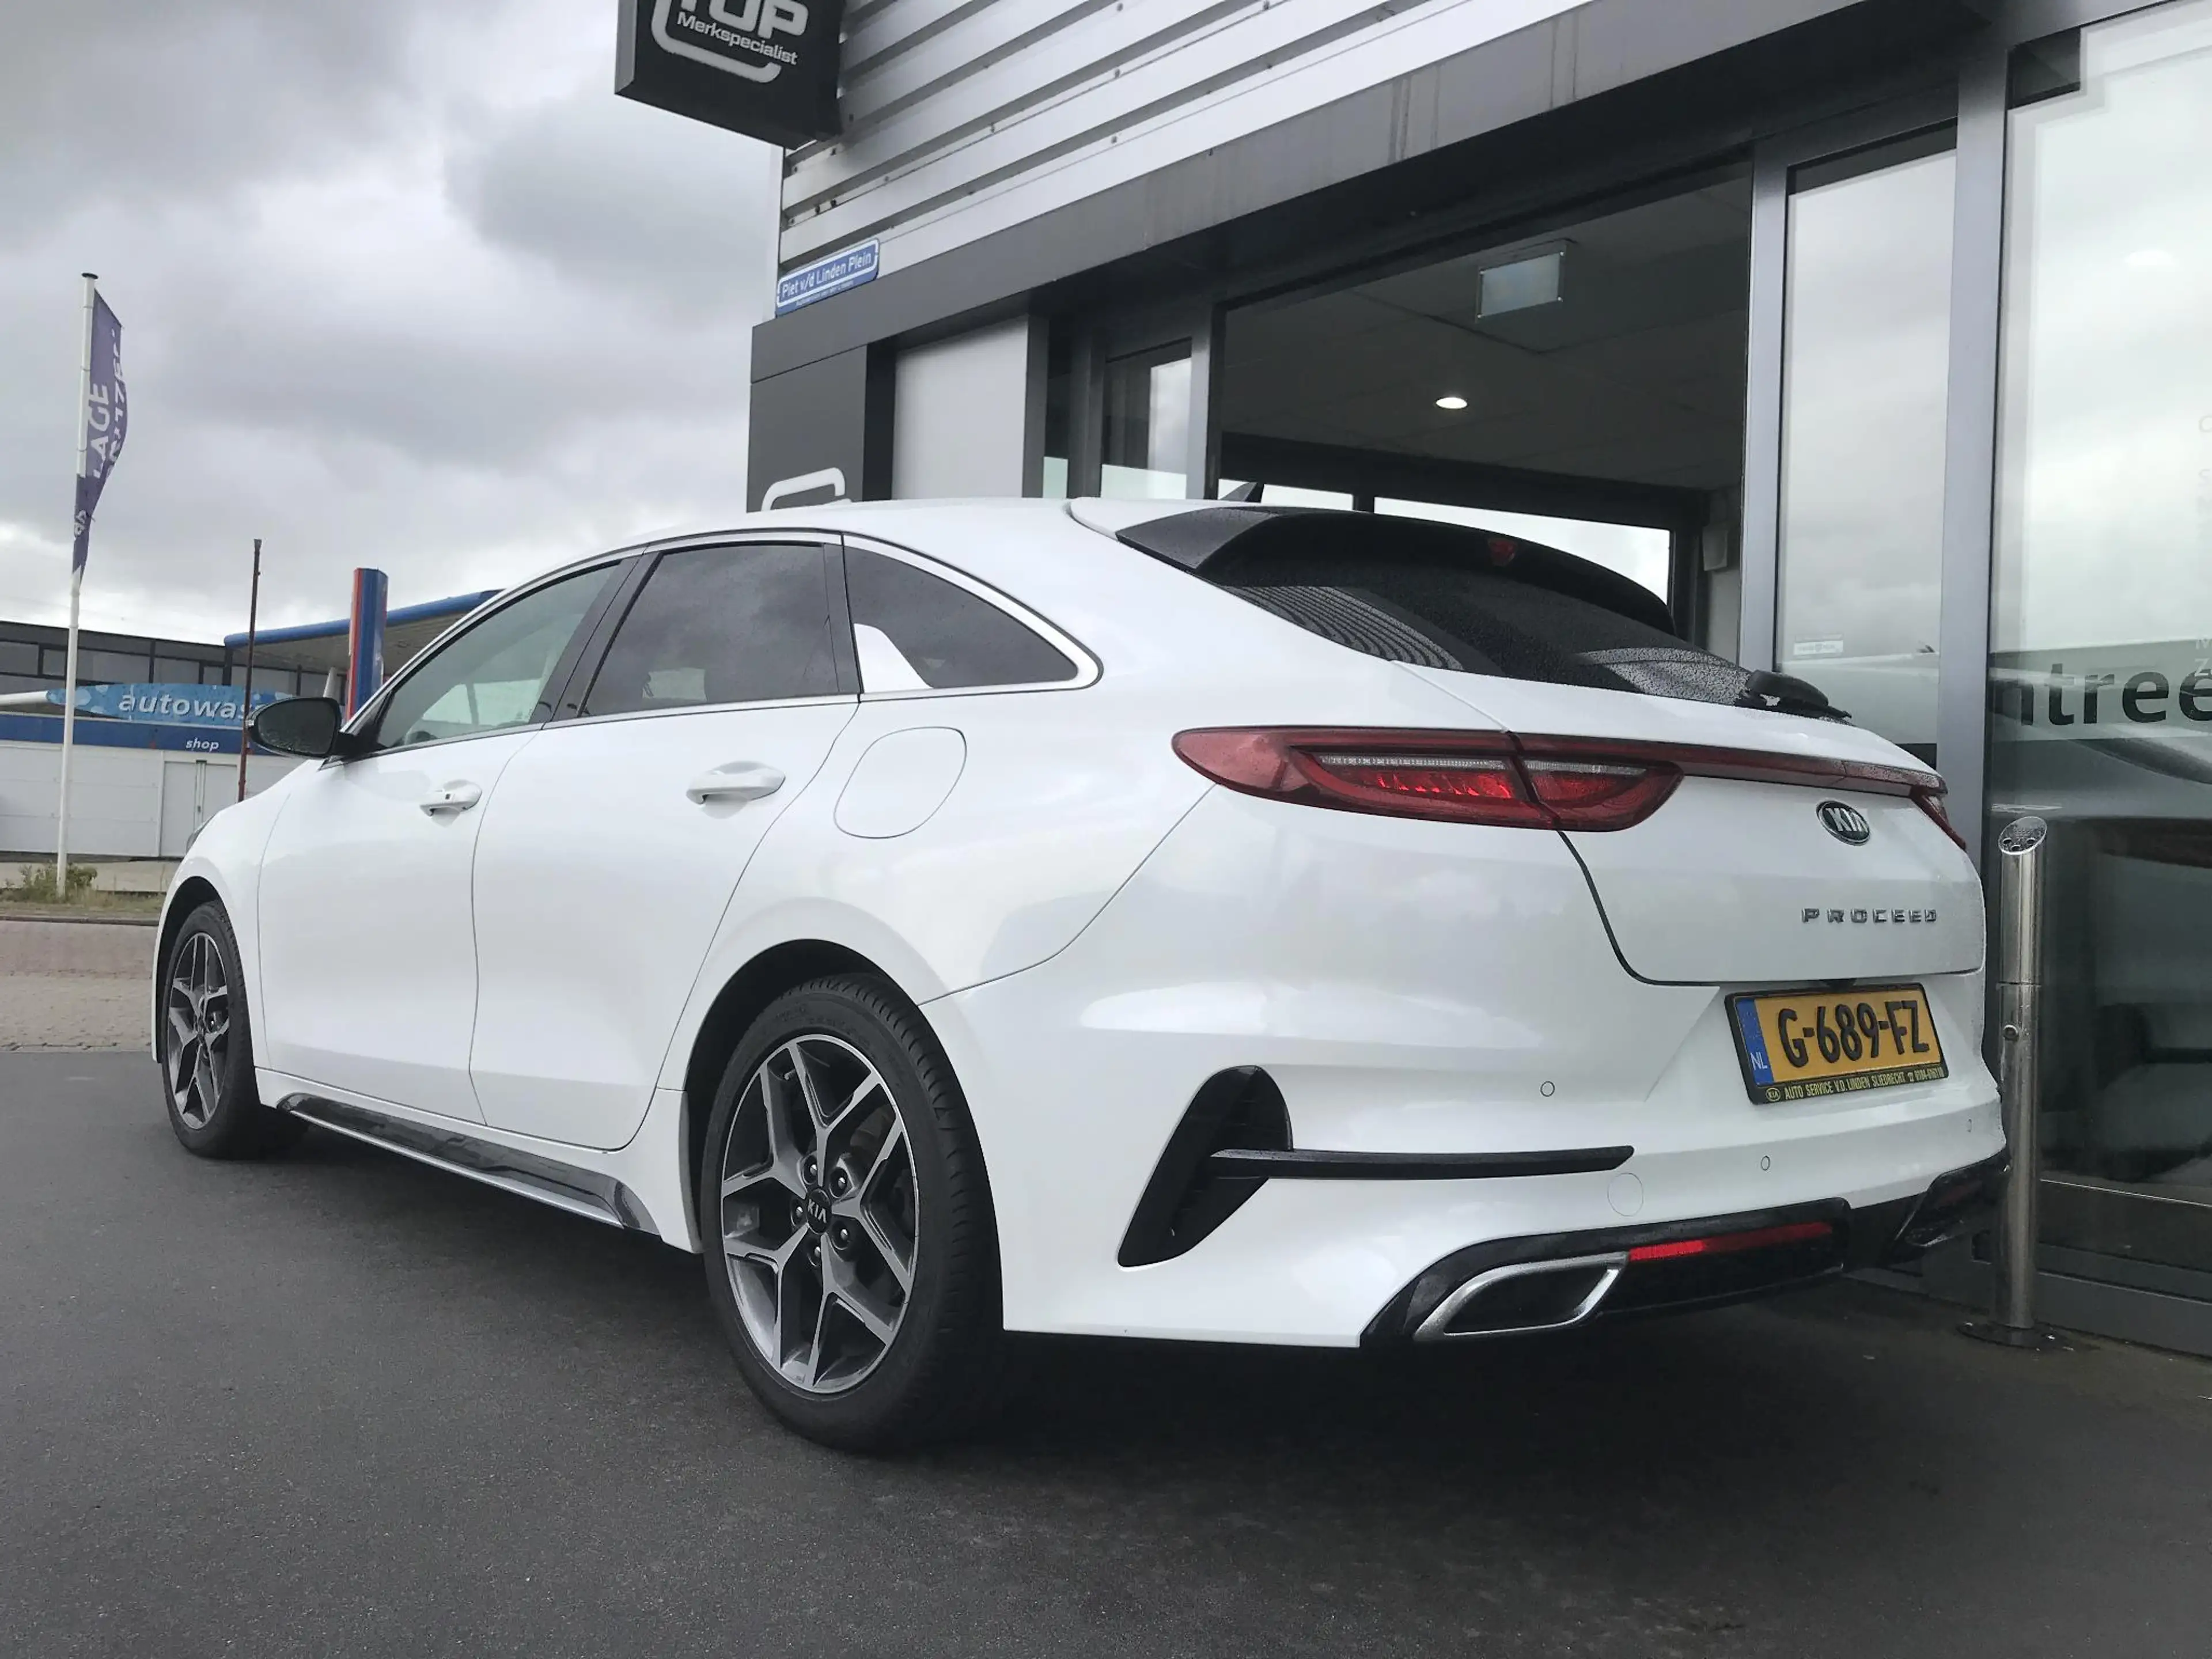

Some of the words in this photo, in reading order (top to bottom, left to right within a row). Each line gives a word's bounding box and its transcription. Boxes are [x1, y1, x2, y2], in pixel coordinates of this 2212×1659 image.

[681, 0, 808, 39] OP
[677, 11, 798, 65] Merkspecialist
[782, 281, 798, 298] Piet
[816, 262, 846, 284] Linden
[847, 251, 872, 273] Plein
[185, 737, 219, 753] shop
[1825, 808, 1868, 832] KIA
[1801, 908, 1937, 923] PROCEED
[1778, 1000, 1930, 1067] G-689-FZ
[1750, 1052, 1768, 1071] NL
[1784, 1085, 1804, 1100] AUTO
[1805, 1081, 1834, 1096] SERVICE
[1847, 1076, 1870, 1090] LINDEN
[1871, 1071, 1906, 1087] SLIEDRECHT
[808, 1198, 827, 1224] KIA
